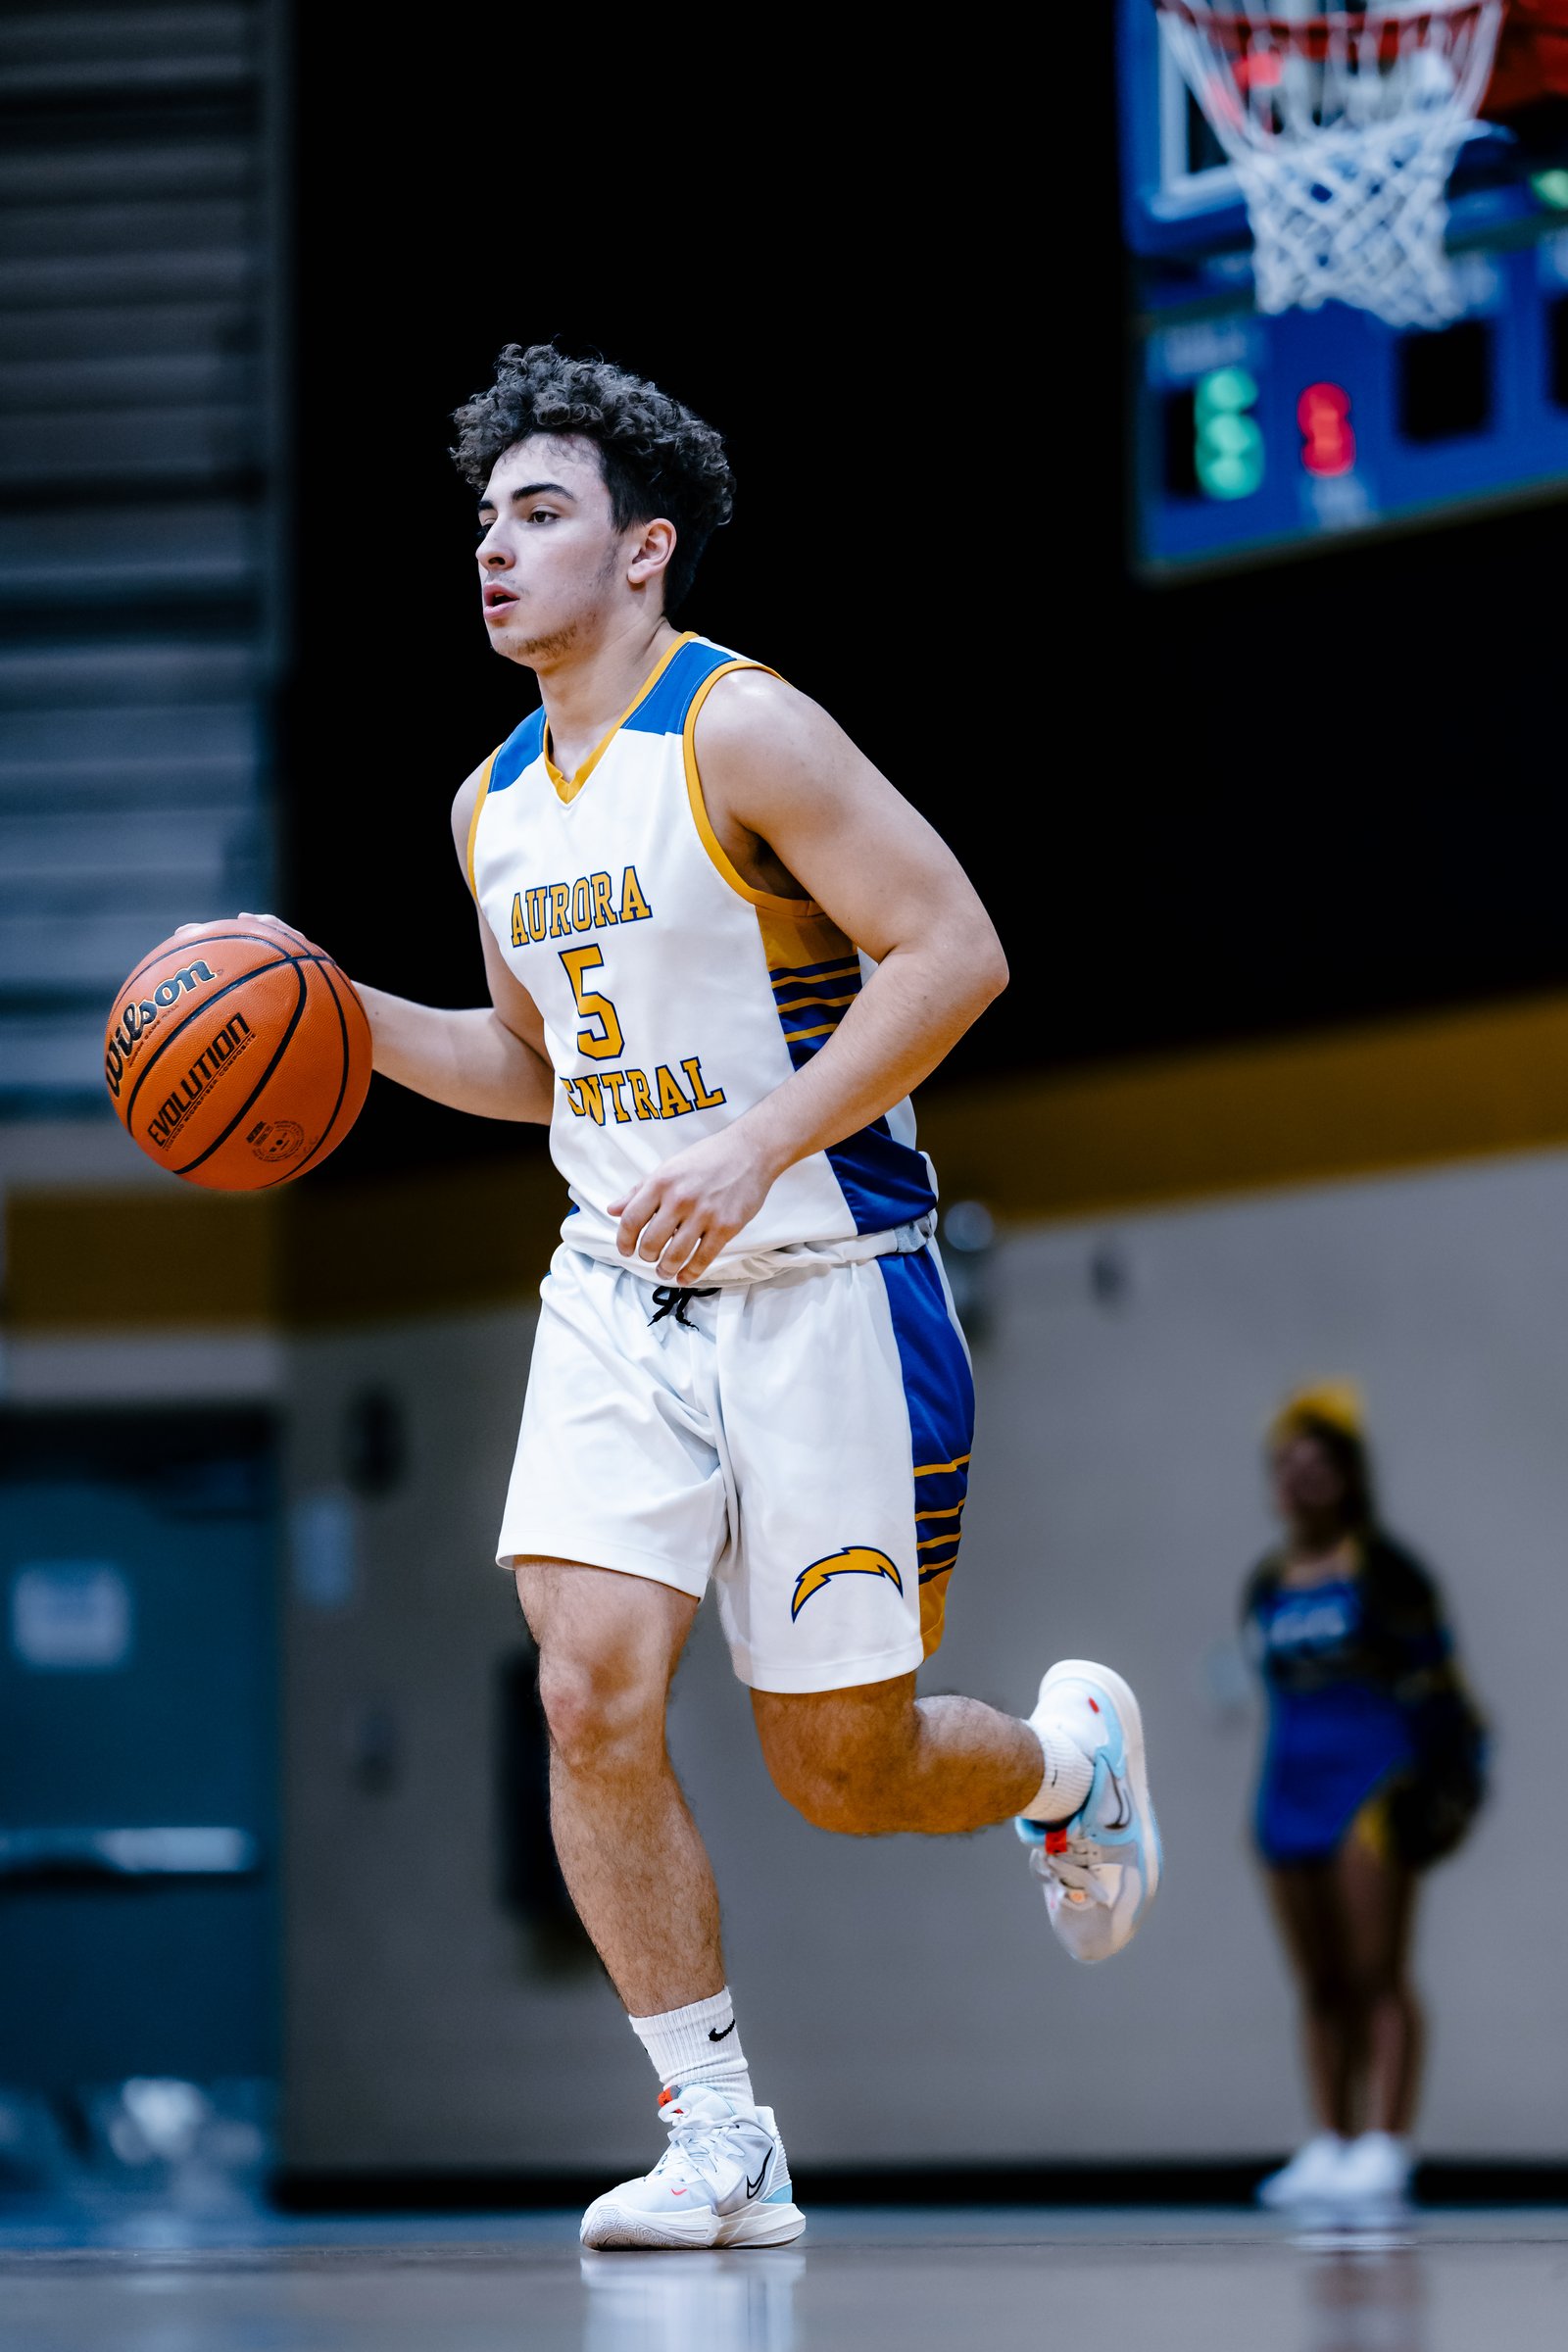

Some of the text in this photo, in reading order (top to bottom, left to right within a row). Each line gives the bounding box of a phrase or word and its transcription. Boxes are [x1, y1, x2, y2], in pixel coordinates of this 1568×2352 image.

[511, 865, 653, 948] AURORA
[106, 959, 217, 1098] Wilson
[558, 943, 625, 1060] 5
[147, 1012, 251, 1147] EVOLUTION
[559, 1055, 727, 1126] ENTRAL
